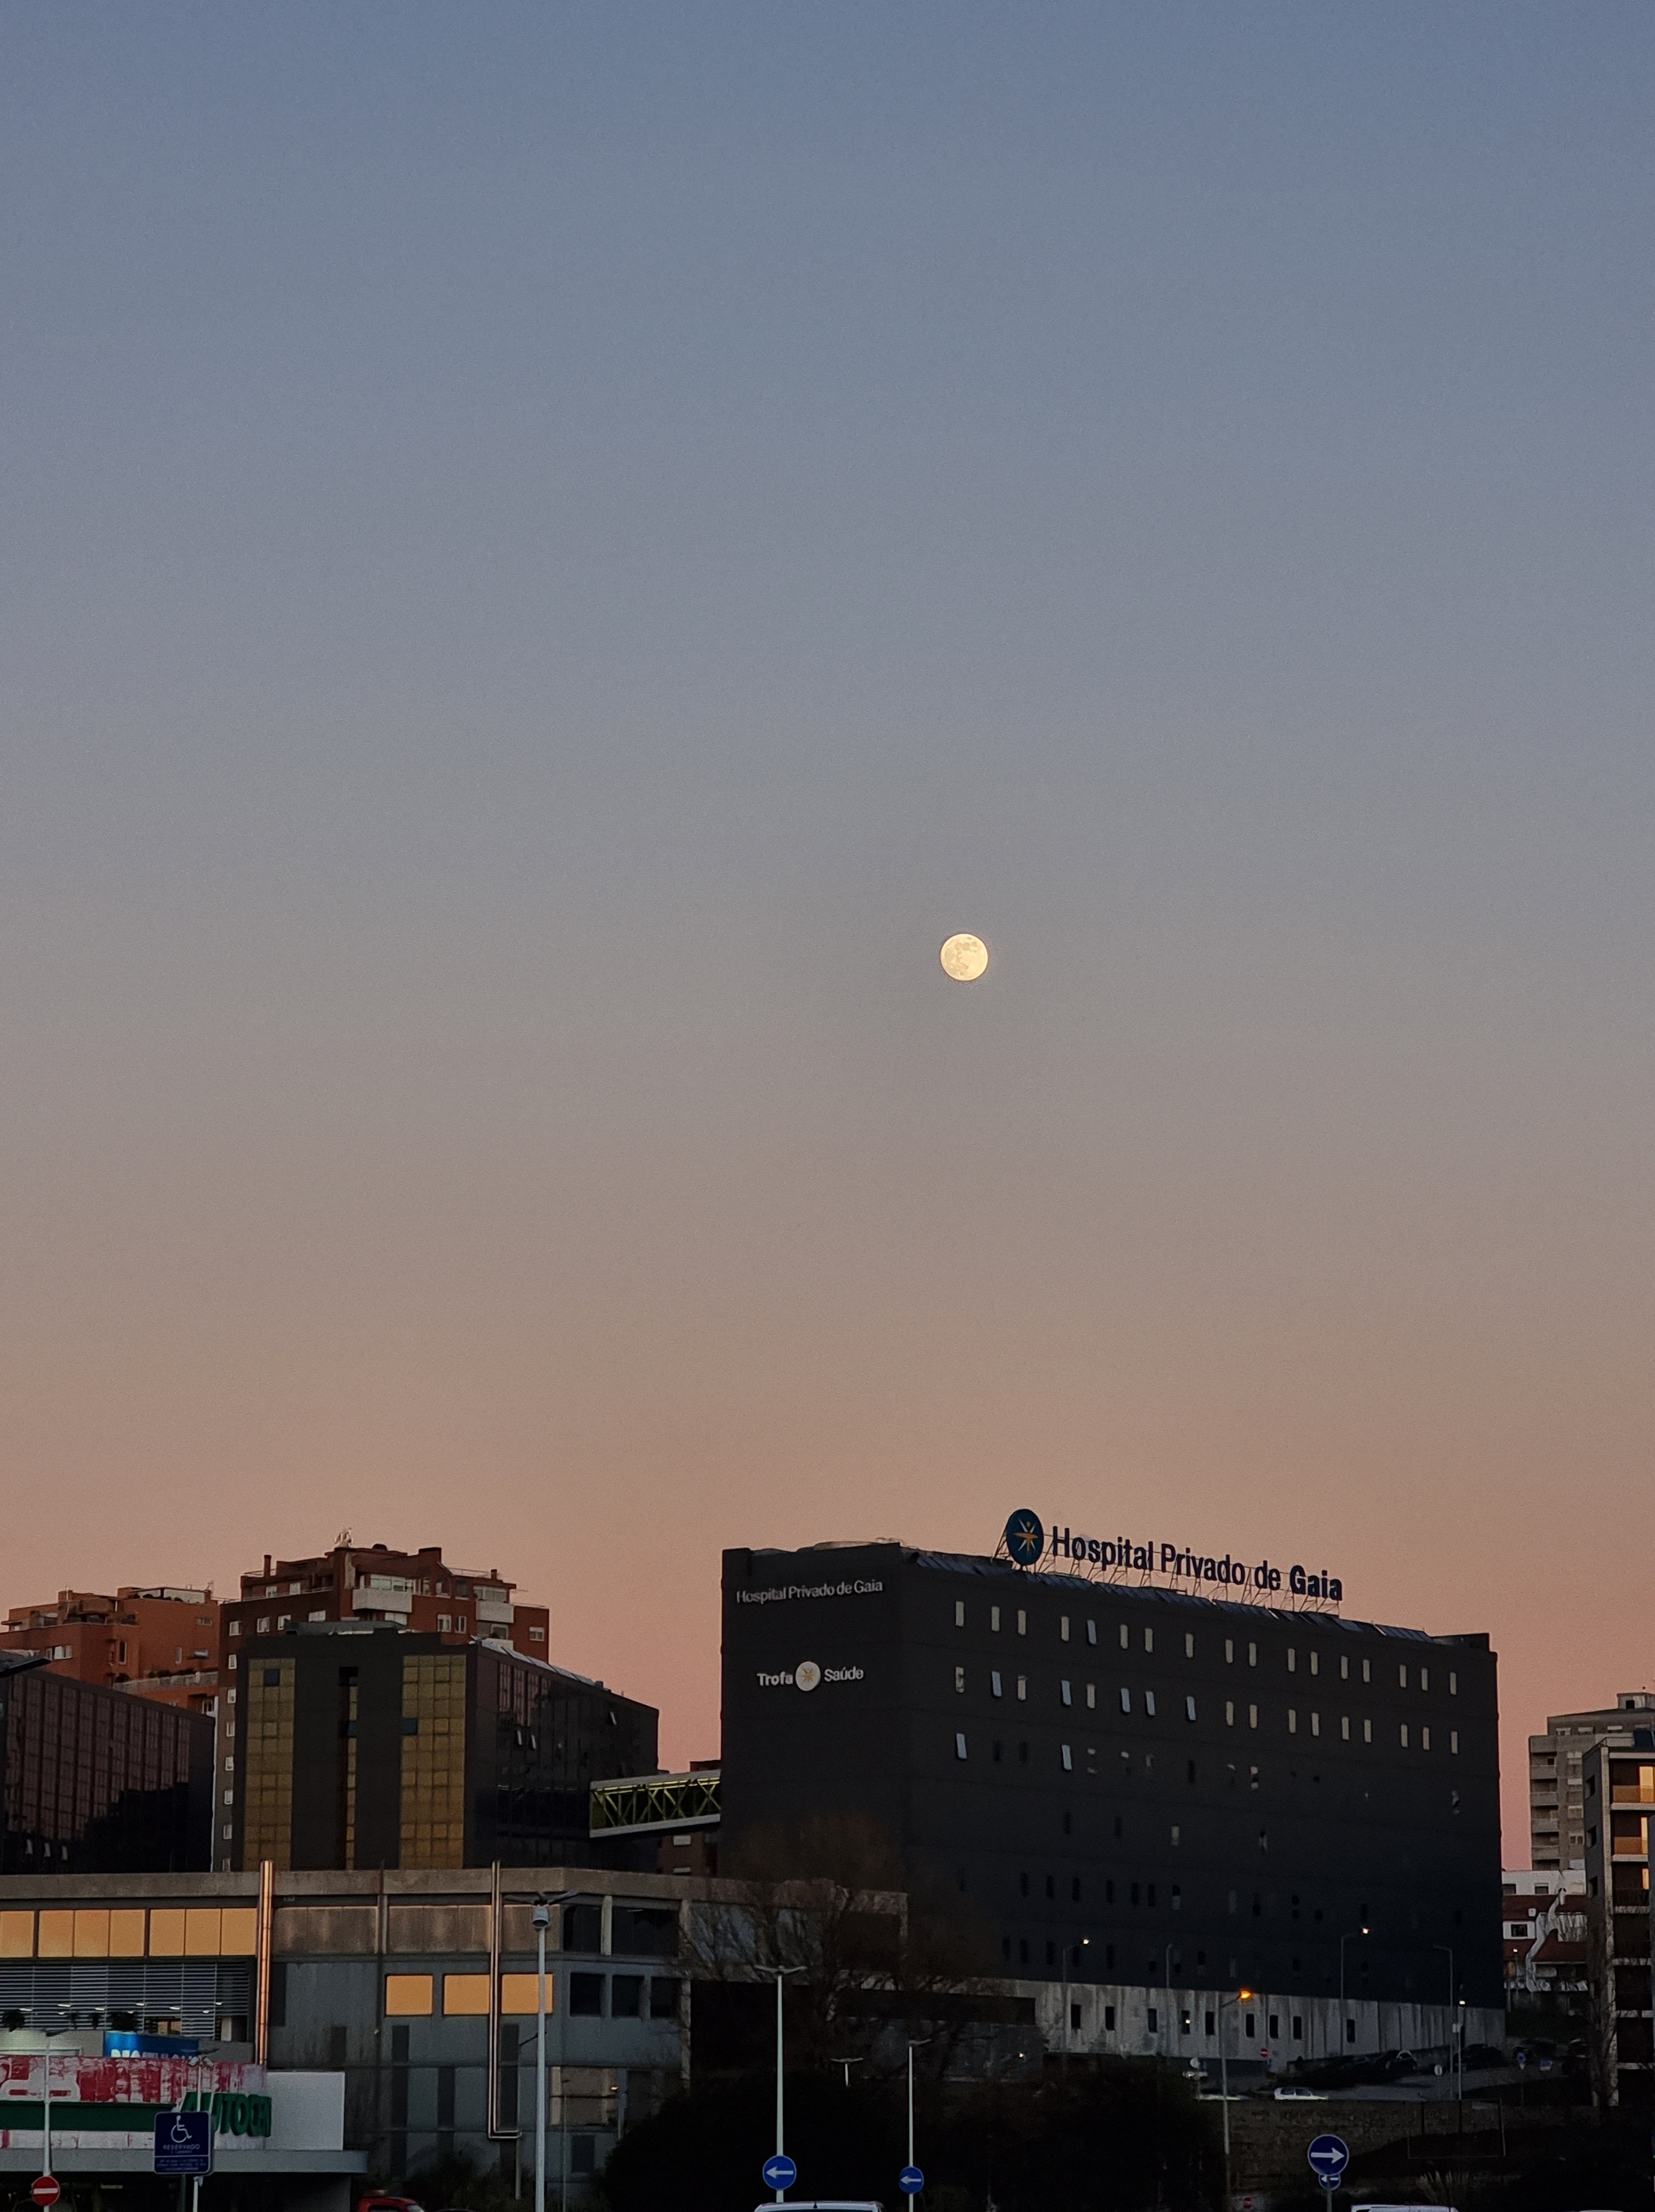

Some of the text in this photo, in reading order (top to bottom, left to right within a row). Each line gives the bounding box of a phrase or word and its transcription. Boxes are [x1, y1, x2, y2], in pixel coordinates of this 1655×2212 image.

[1052, 1526, 1343, 1601] Hospital Privado de Gaia
[736, 1579, 883, 1604] Hospital Privado de Gaia
[757, 1666, 864, 1686] Trofa Saúde
